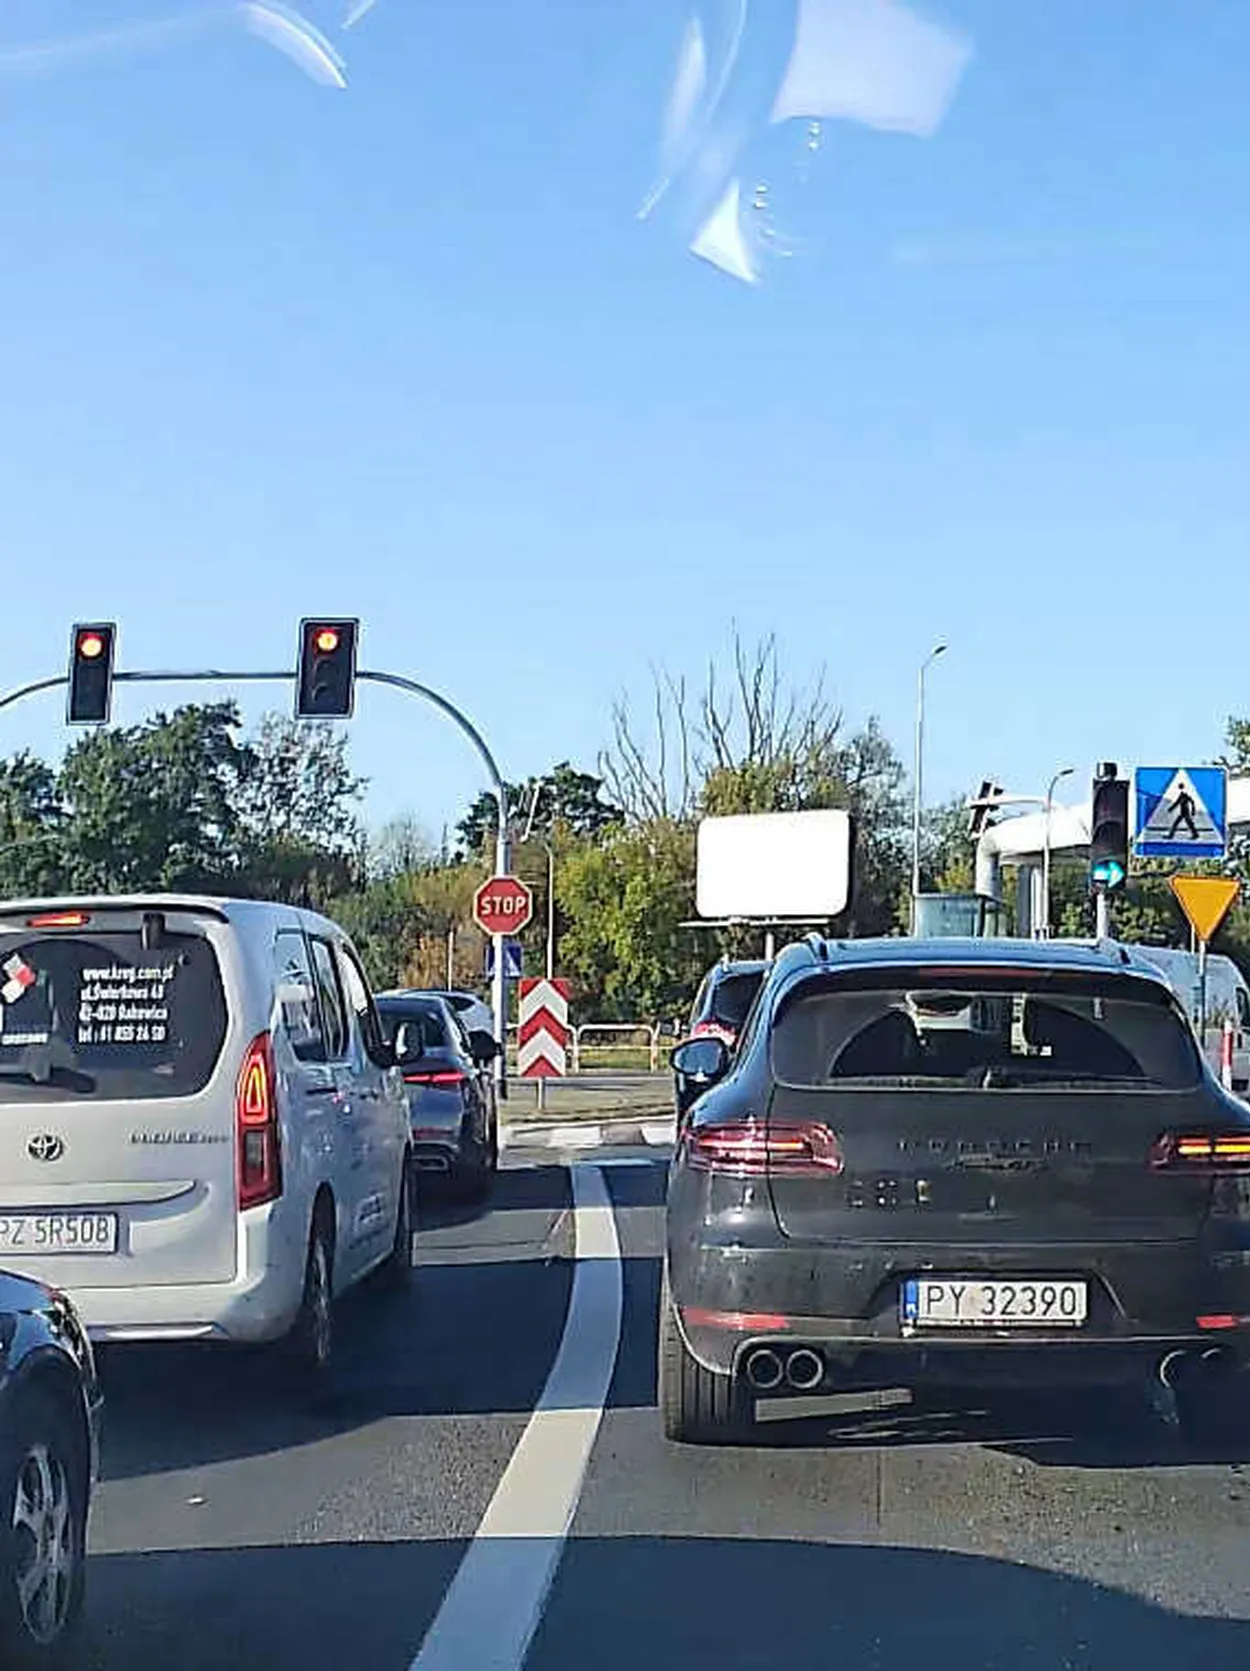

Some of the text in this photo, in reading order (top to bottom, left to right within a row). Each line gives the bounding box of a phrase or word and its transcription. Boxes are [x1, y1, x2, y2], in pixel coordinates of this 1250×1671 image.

[480, 896, 527, 915] STOP
[34, 1217, 109, 1244] 5R508
[927, 1285, 967, 1315] PY
[981, 1286, 1077, 1316] 32390
